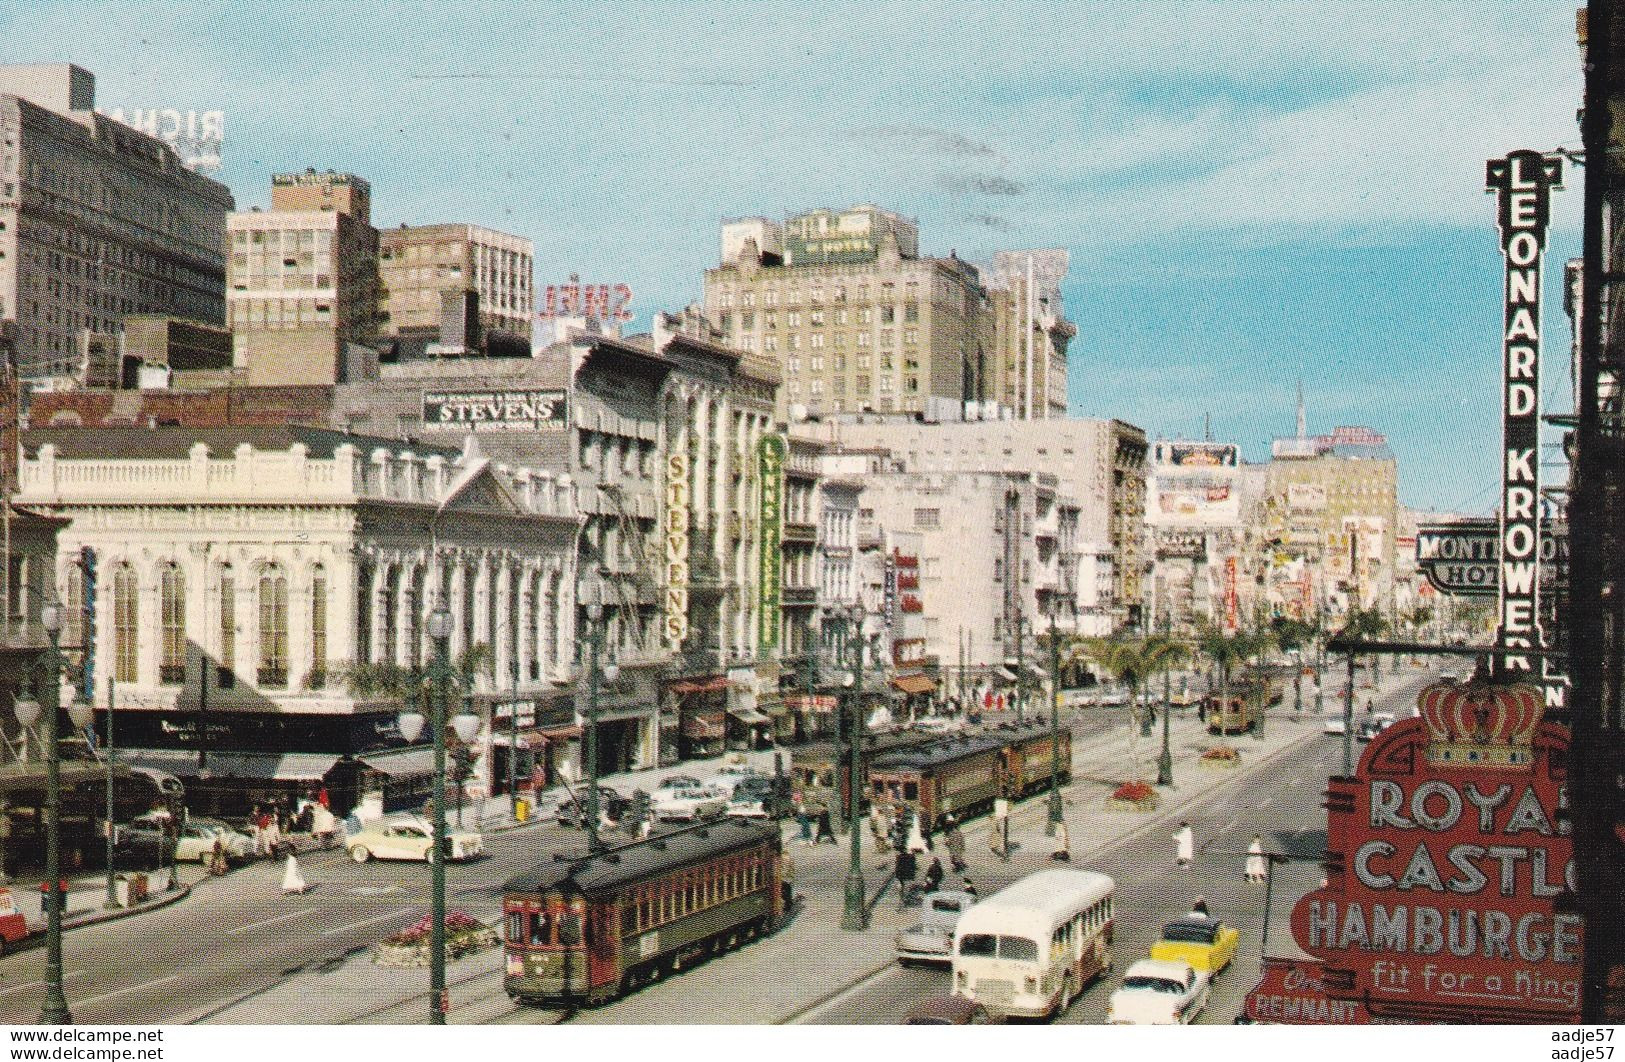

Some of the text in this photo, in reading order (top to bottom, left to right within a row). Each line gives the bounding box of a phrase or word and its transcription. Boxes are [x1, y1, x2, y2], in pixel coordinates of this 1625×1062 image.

[439, 399, 553, 421] STEVENS
[1503, 157, 1538, 671] LEONARD KROWER
[668, 458, 688, 638] STEVENS
[1354, 841, 1576, 895] CASTL
[1371, 961, 1411, 988] fit
[1422, 964, 1476, 992] for
[1486, 977, 1504, 991] a
